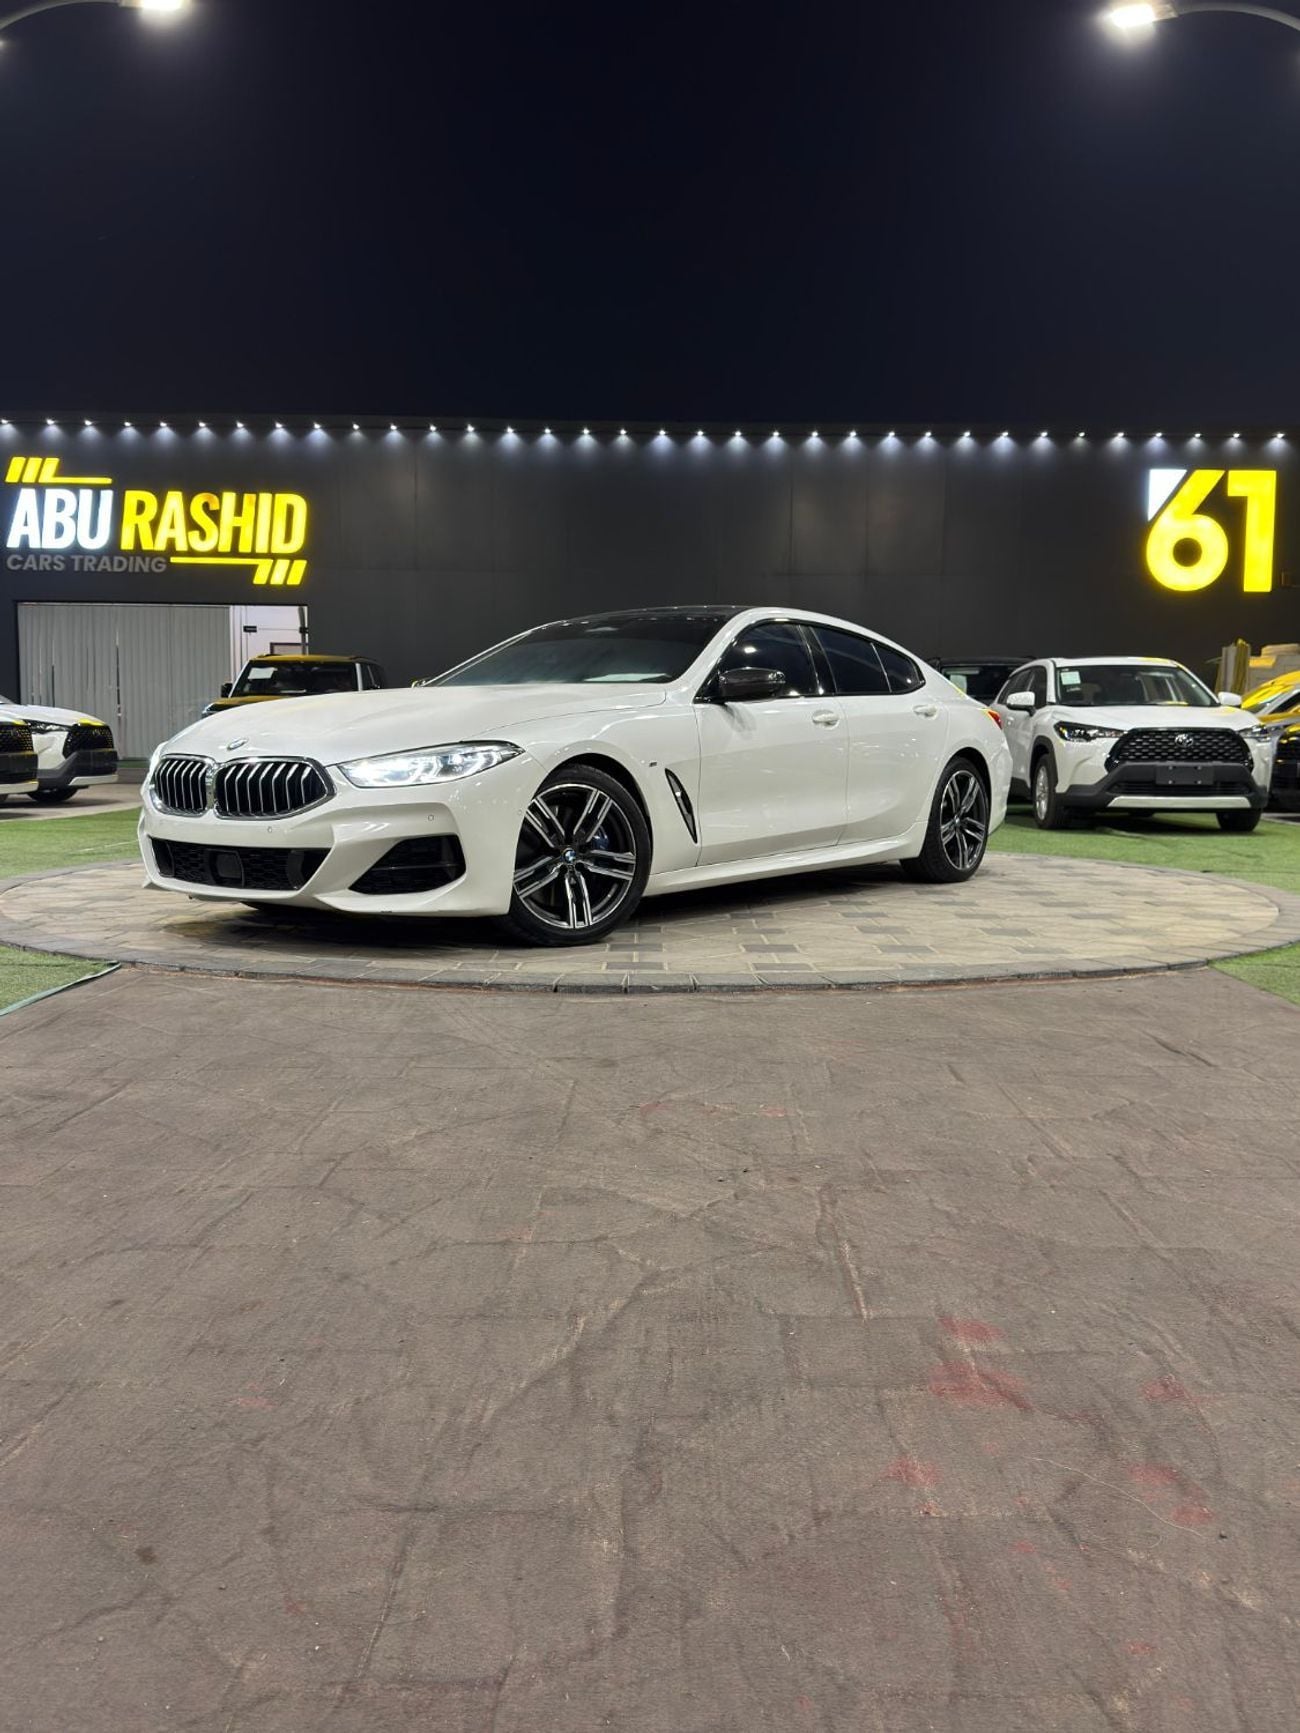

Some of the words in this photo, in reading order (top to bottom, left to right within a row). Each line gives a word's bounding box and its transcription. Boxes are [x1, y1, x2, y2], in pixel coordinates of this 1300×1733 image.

[6, 488, 114, 550] ABU
[120, 489, 308, 554] RASHID
[1146, 469, 1277, 593] 61
[6, 554, 66, 572] CARS
[71, 555, 168, 573] TRADING
